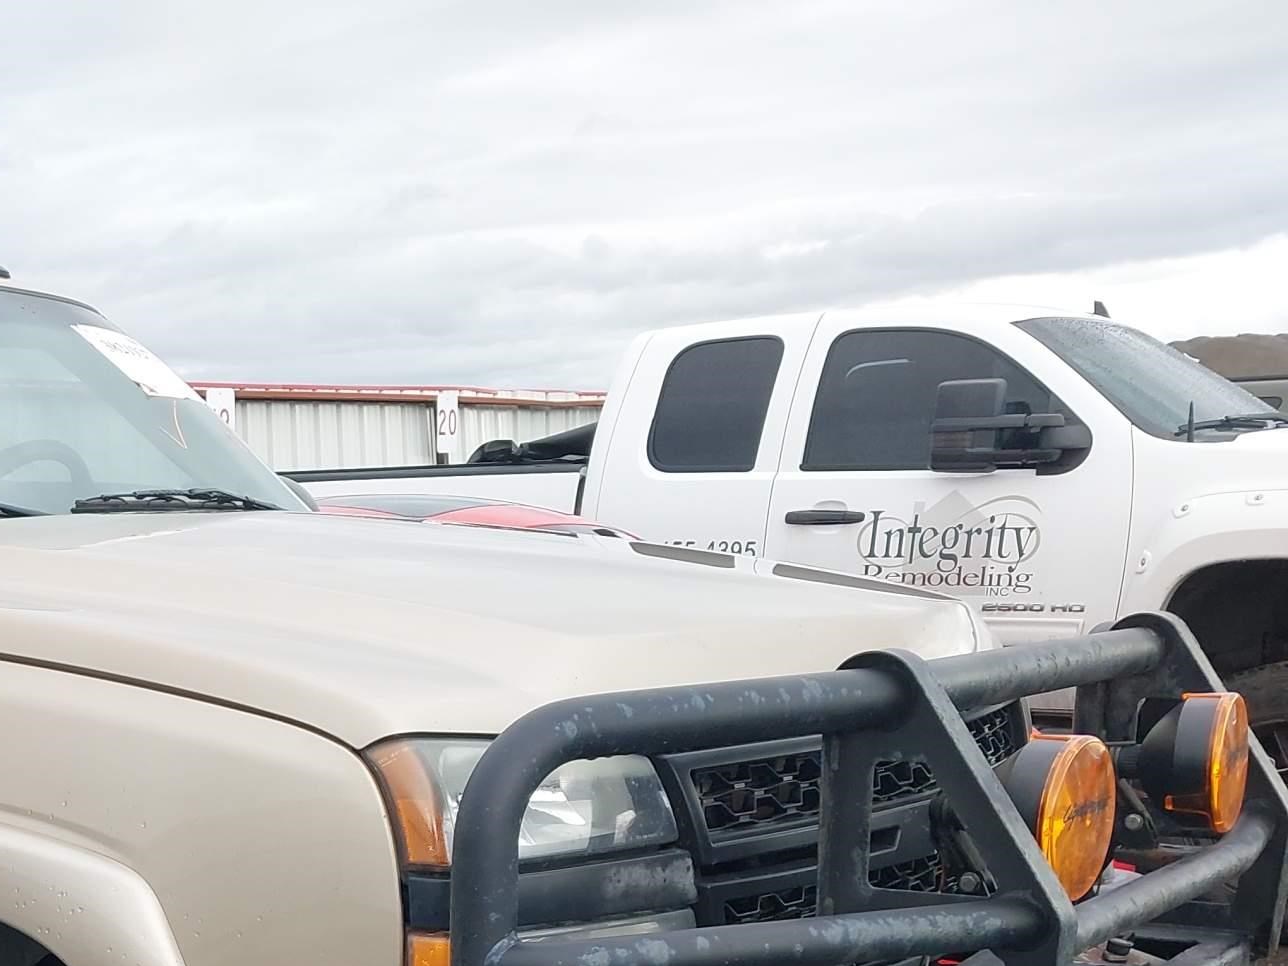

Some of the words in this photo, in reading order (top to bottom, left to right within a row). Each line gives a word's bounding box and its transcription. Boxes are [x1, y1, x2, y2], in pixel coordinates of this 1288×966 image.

[438, 409, 457, 435] 20
[863, 510, 1037, 573] Integrity
[985, 586, 1010, 598] INC
[981, 603, 1045, 613] 2500
[1050, 603, 1086, 613] HD
